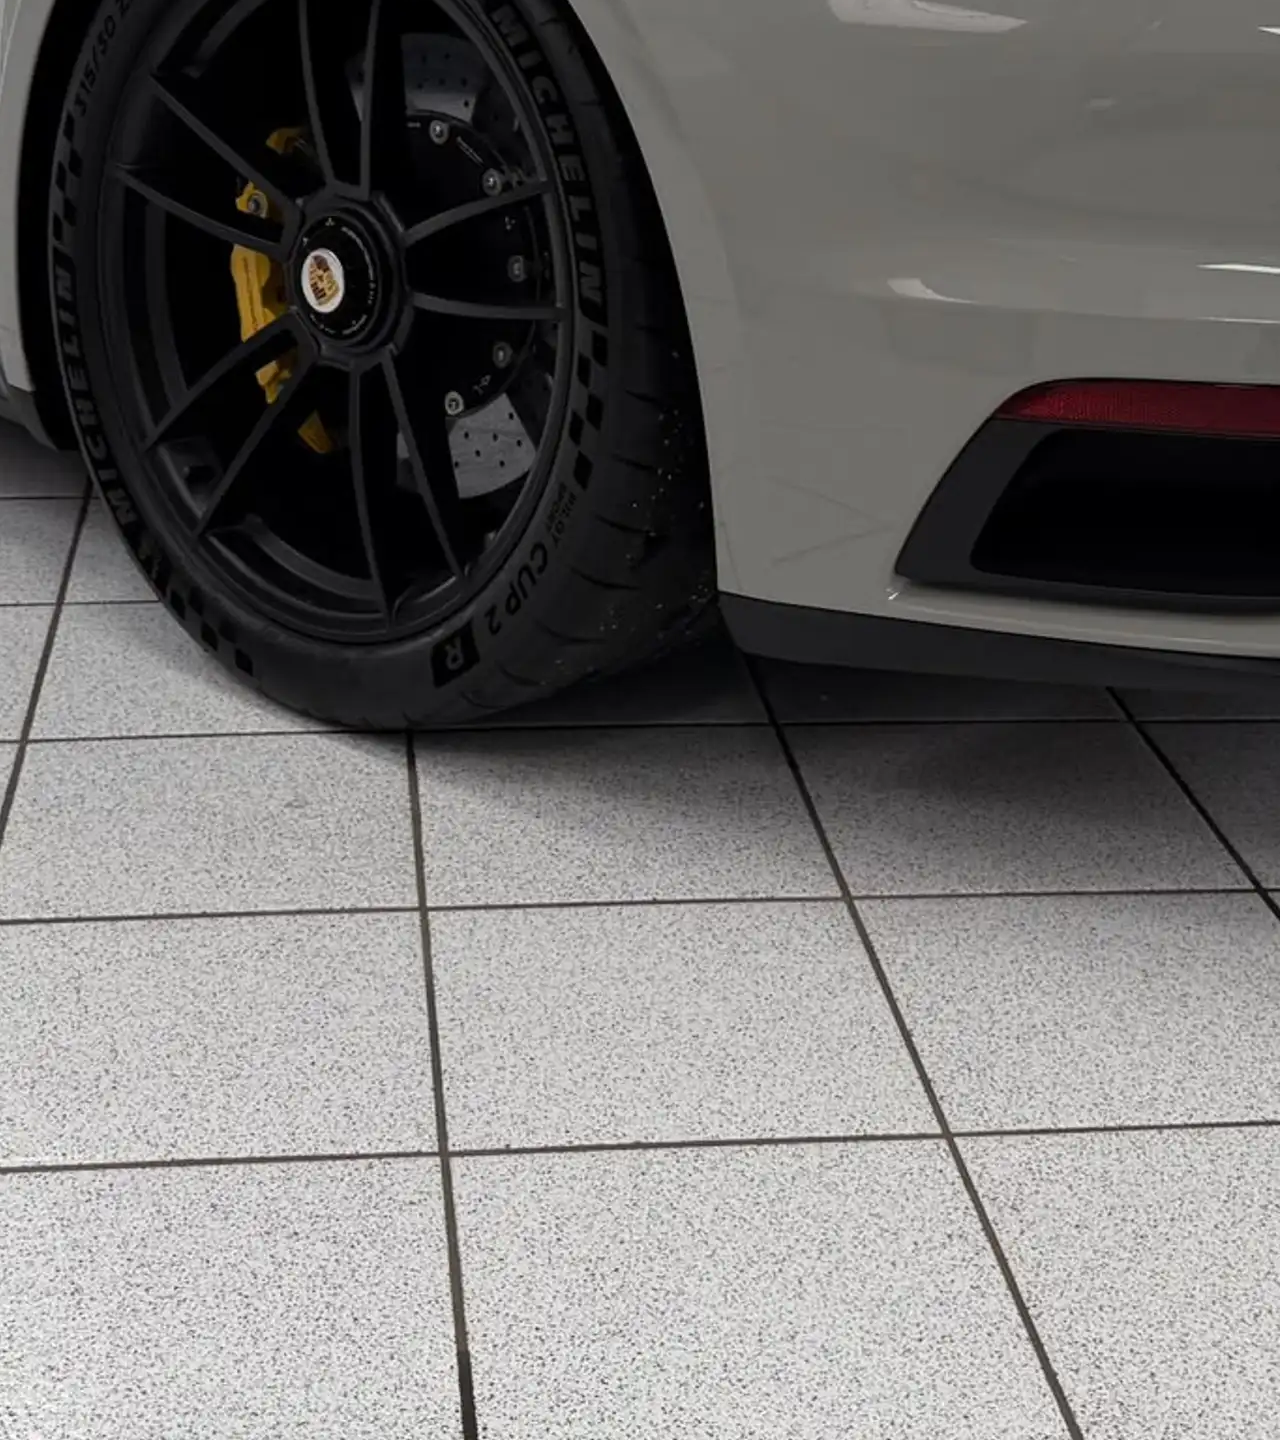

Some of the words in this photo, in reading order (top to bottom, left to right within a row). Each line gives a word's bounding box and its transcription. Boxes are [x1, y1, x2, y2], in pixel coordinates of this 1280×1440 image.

[490, 1, 605, 312] MICHELIN
[54, 263, 139, 525] MICHELIN
[505, 542, 548, 615] CUP
[444, 634, 464, 672] R
[484, 604, 502, 635] 2
